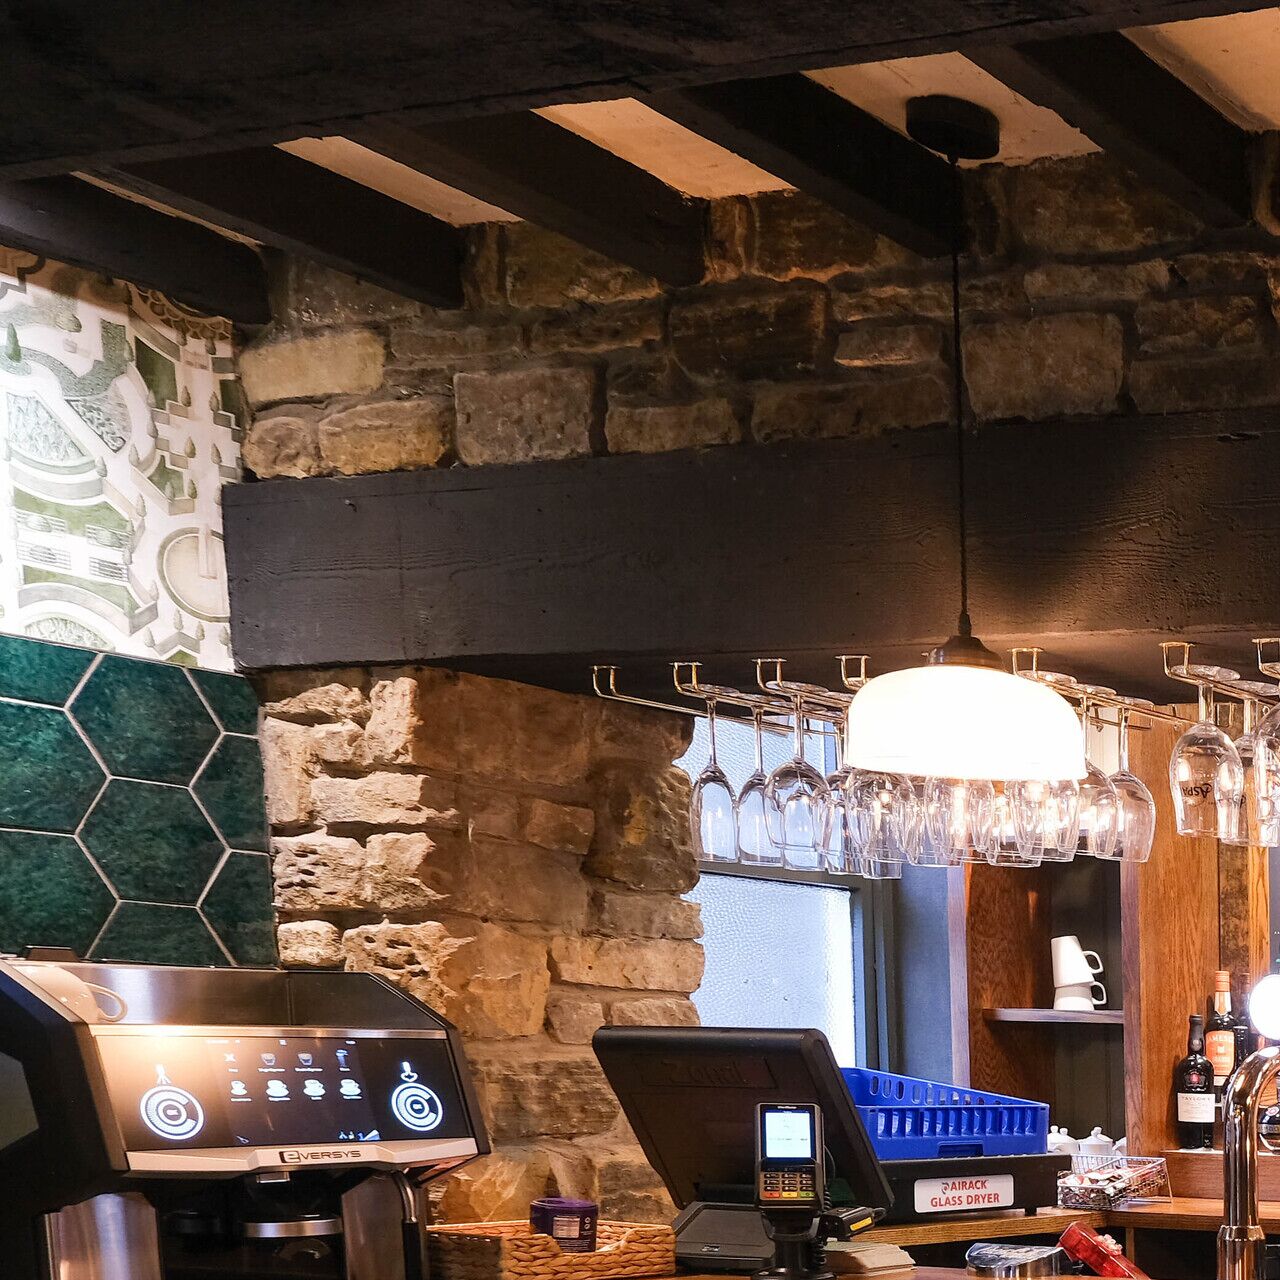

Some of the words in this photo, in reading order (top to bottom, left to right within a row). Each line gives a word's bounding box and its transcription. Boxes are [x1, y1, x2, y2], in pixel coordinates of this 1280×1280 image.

[1181, 782, 1212, 798] ASPA
[950, 1180, 988, 1191] AIRACK
[931, 1195, 963, 1208] GLASS
[966, 1193, 1000, 1206] DRYER
